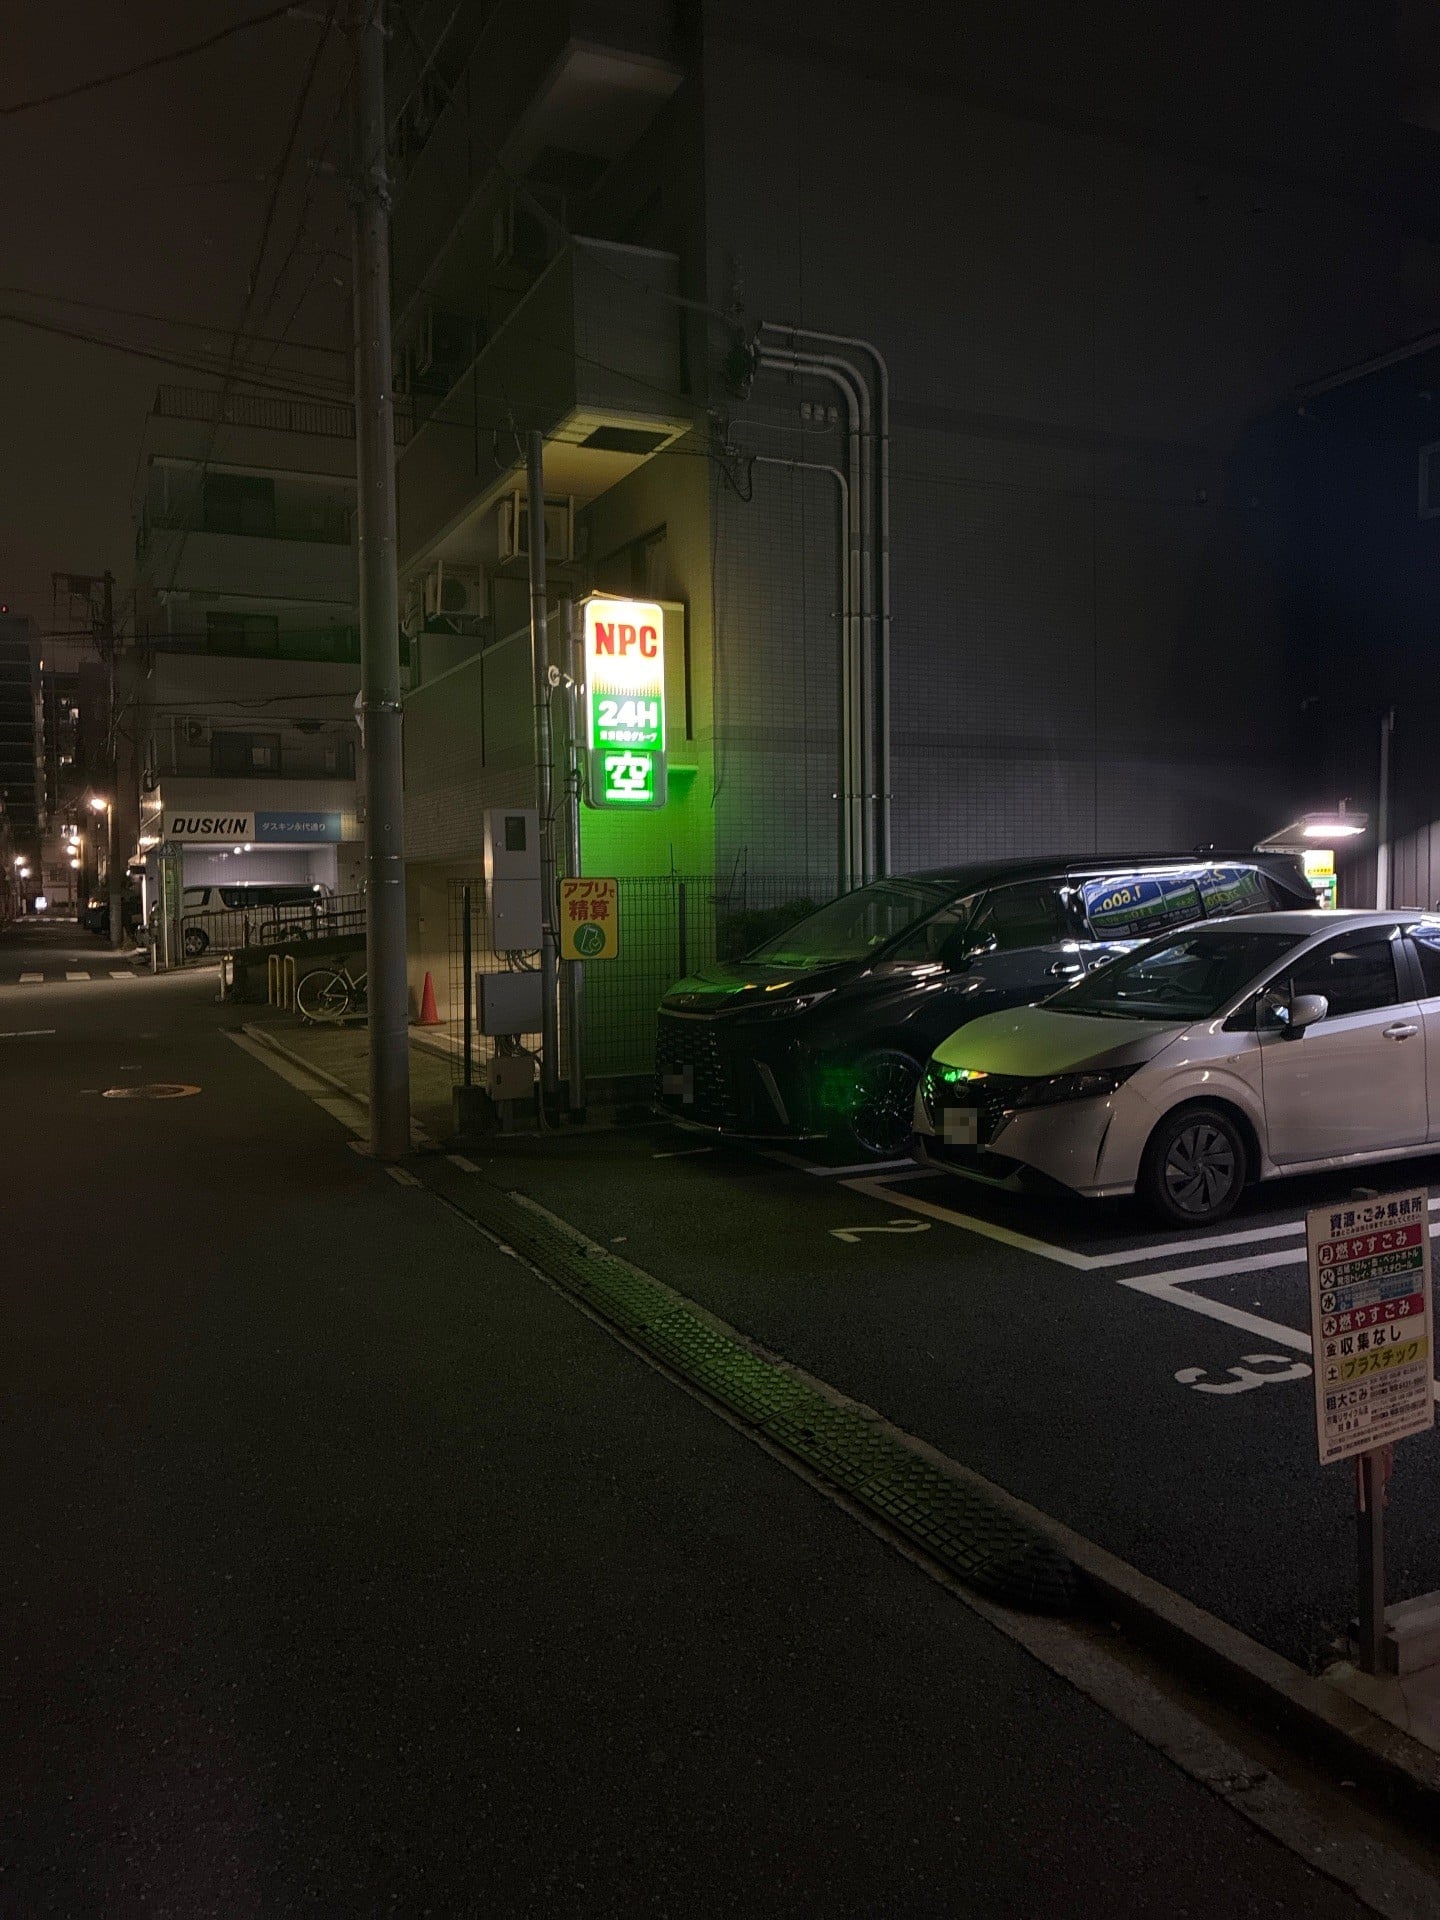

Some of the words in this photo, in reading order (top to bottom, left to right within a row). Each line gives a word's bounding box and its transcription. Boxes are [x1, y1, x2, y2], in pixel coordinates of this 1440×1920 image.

[594, 622, 658, 658] NPC
[598, 700, 658, 728] 24H
[604, 750, 653, 801] 空
[563, 881, 615, 898] アプリで
[568, 900, 610, 920] 精算
[1330, 1197, 1422, 1230] 資源・ごみ集積所
[827, 1219, 932, 1243] 2
[1335, 1230, 1408, 1261] 燃やすごみ
[1323, 1272, 1333, 1285] 火
[1323, 1295, 1334, 1309] 水
[1338, 1299, 1411, 1332] 燃やすごみ
[1326, 1343, 1337, 1357] 金
[1340, 1325, 1402, 1354] 収集なし
[1173, 1353, 1313, 1395] 3
[1344, 1342, 1419, 1378] プラスチック
[1326, 1388, 1368, 1411] 粗大ごみ
